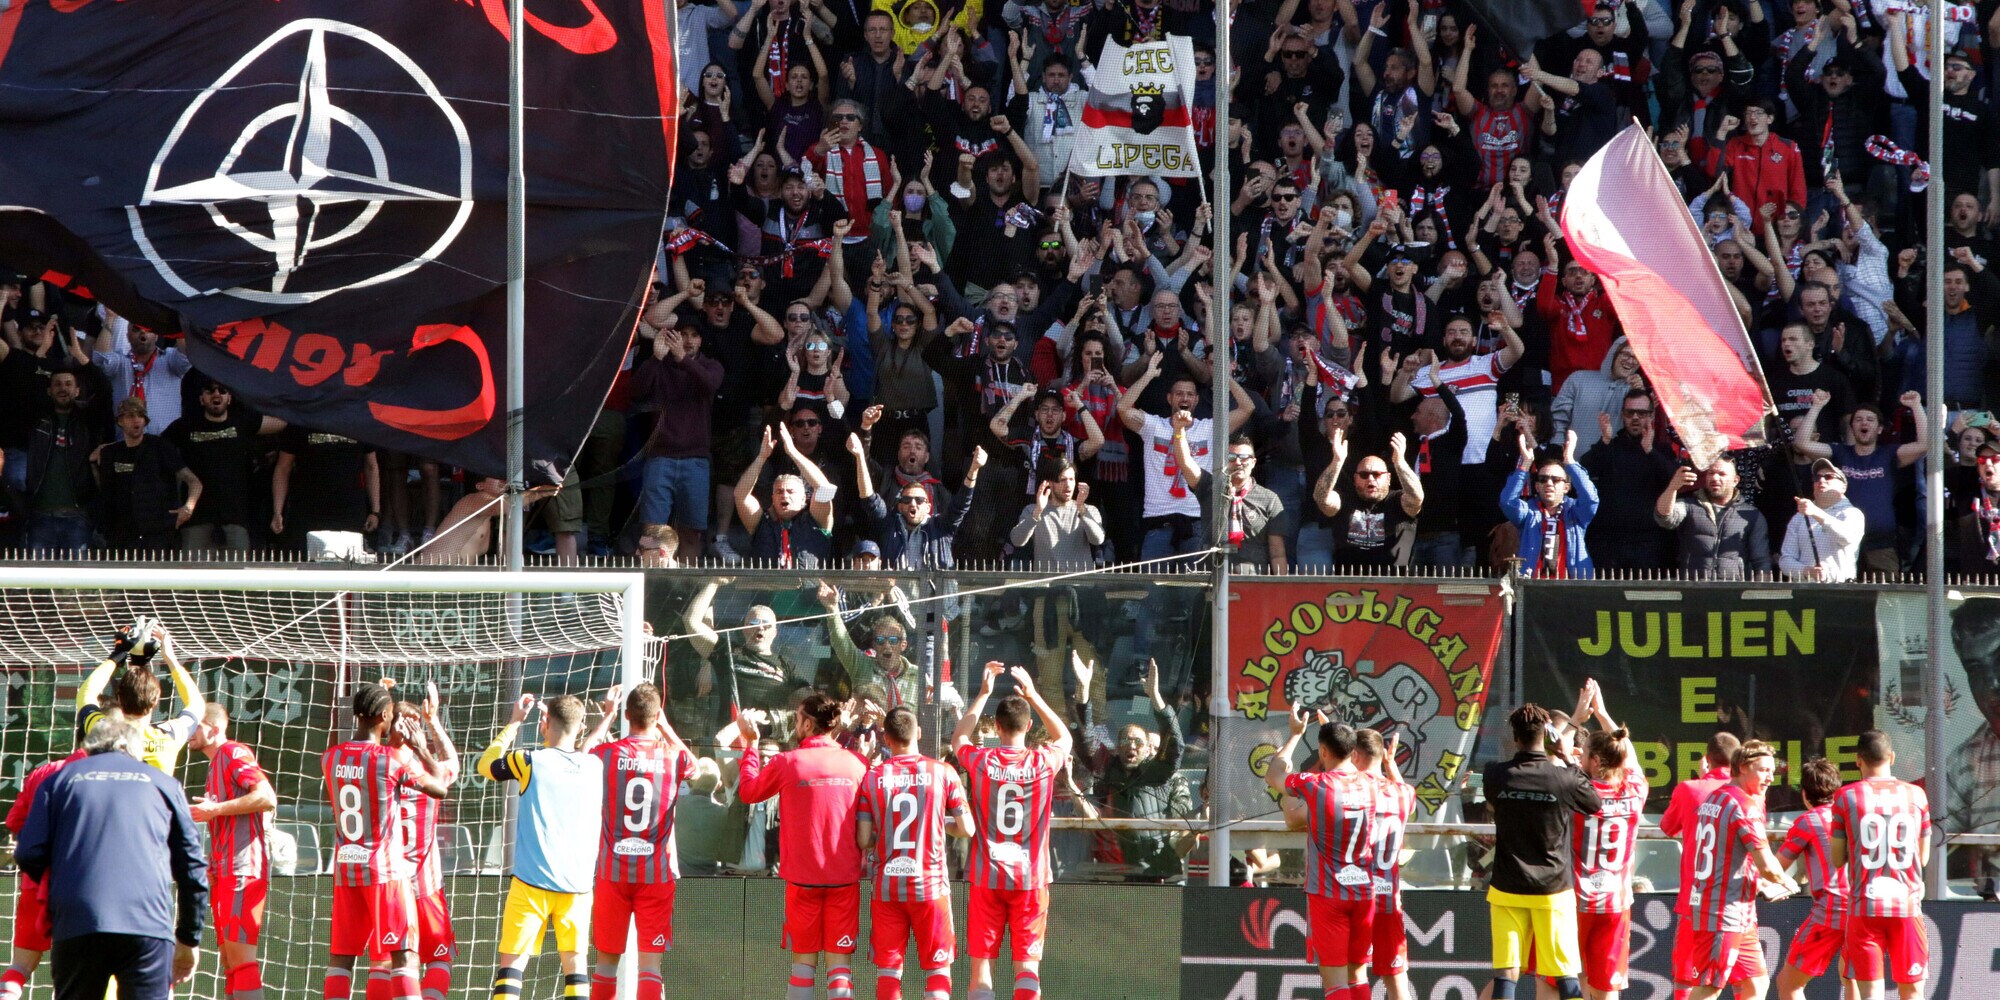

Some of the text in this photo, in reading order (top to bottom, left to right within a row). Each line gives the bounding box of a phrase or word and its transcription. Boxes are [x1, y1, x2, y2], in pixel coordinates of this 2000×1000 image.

[1122, 48, 1174, 75] CHE
[1096, 143, 1194, 171] LIPEGA
[1577, 608, 1816, 659] JULIEN
[1392, 675, 1428, 720] CR
[1680, 676, 1718, 724] E
[68, 770, 152, 785] ACERBIS
[335, 764, 364, 780] GONDO
[796, 777, 854, 787] ACERBIS
[339, 783, 364, 842] 8
[623, 776, 654, 833] 9
[996, 782, 1025, 836] 6
[1497, 790, 1558, 803] ACERBIS
[892, 792, 918, 850] 2
[1344, 810, 1364, 864] 7
[1585, 816, 1628, 871] 19
[1860, 813, 1915, 871] 99
[616, 845, 652, 854] CREMONA
[885, 865, 917, 875] CREMON
